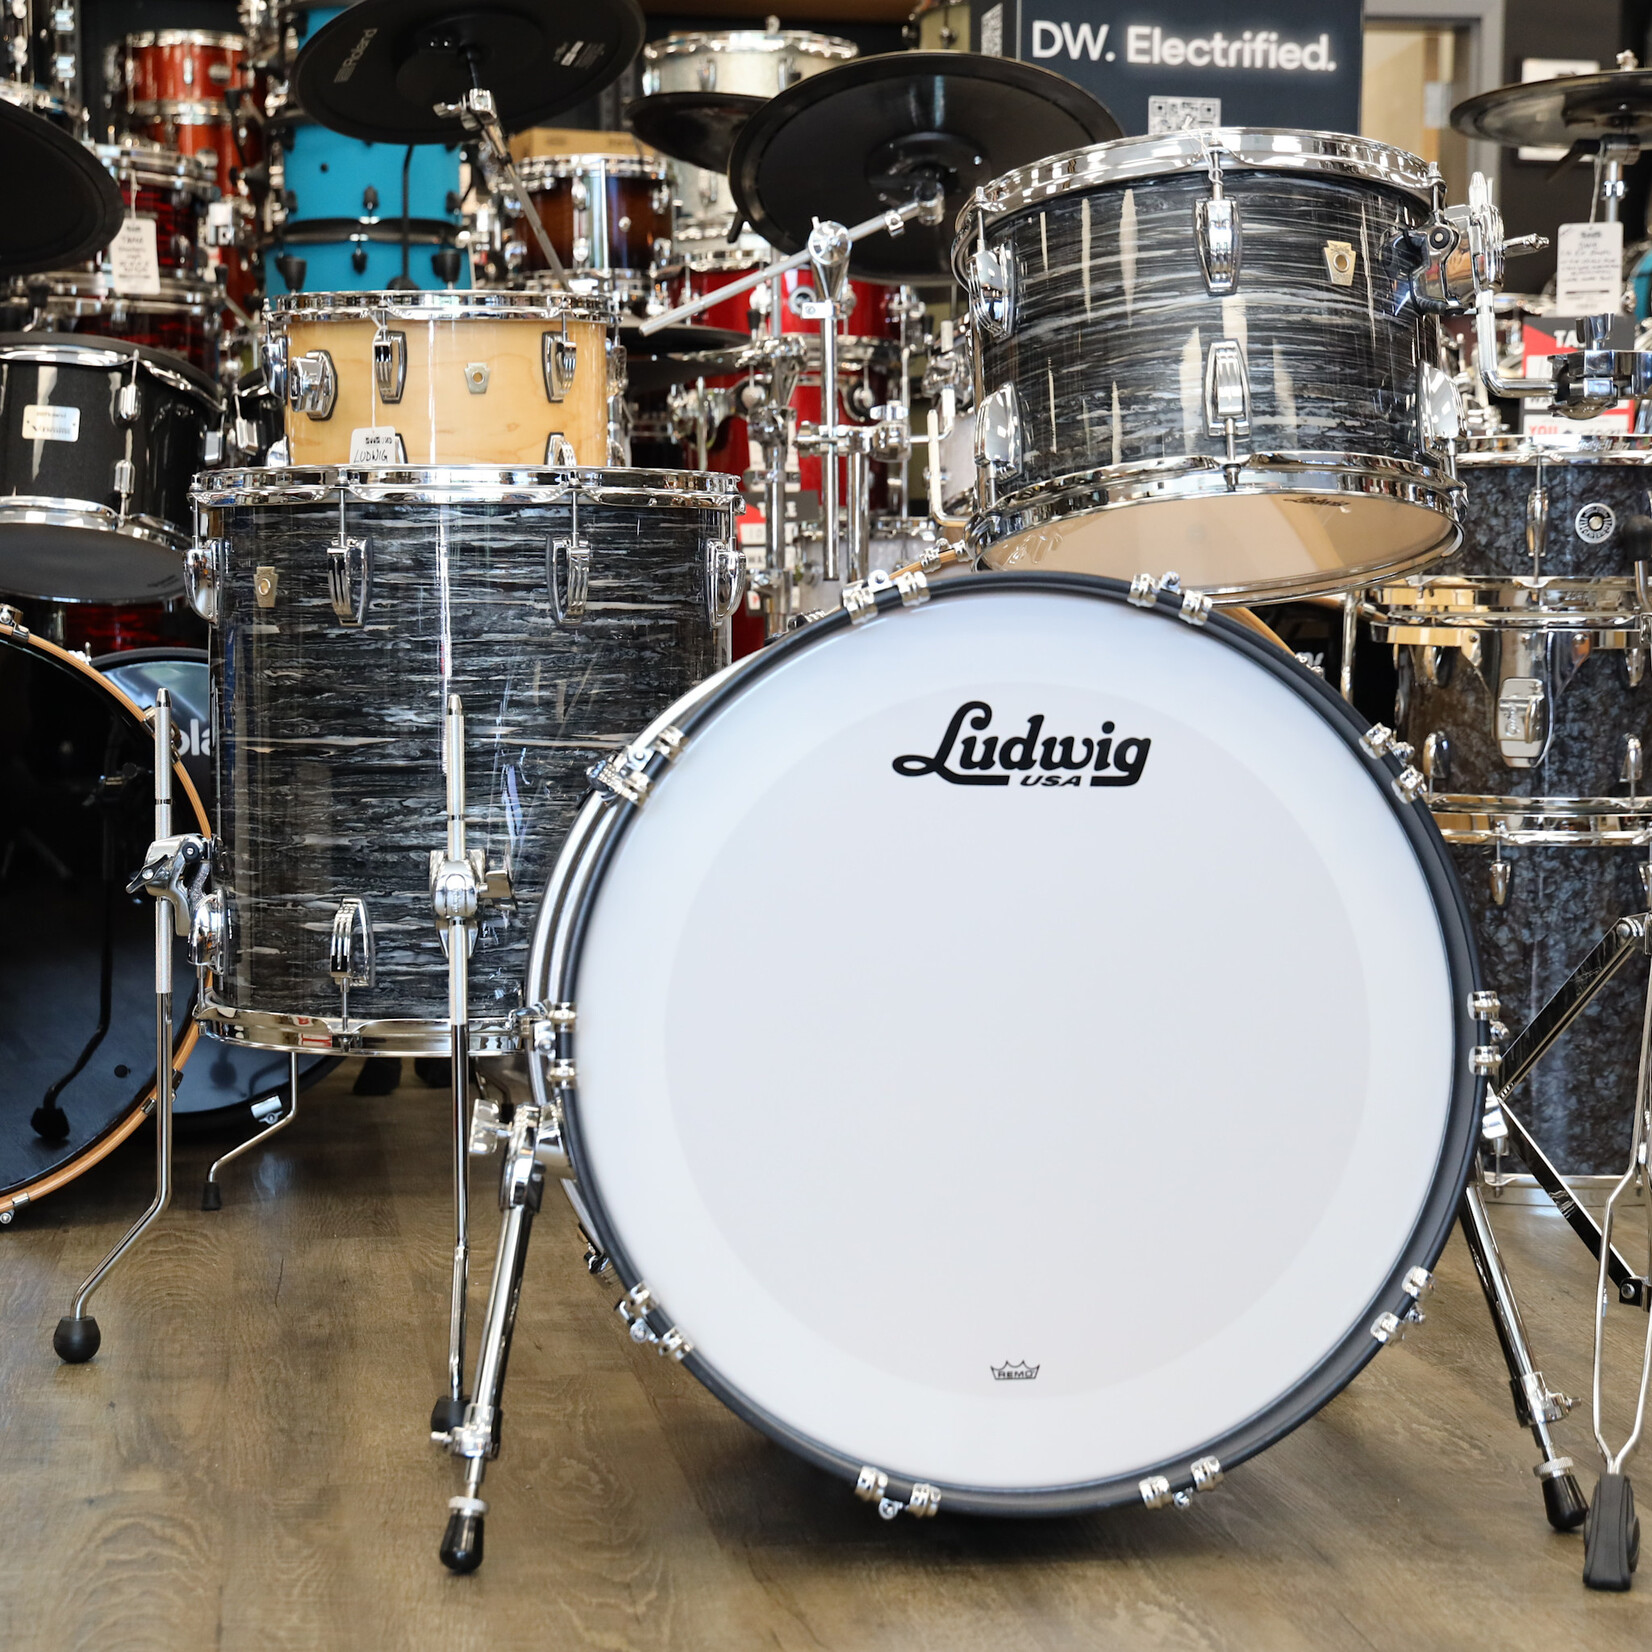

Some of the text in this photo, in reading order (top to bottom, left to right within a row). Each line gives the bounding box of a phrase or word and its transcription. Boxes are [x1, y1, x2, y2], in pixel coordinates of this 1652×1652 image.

[1032, 20, 1337, 71] DW. Electrified.
[353, 449, 388, 463] LUDWIG
[892, 700, 1152, 787] Ludwig
[1020, 775, 1082, 787] USA
[998, 1370, 1034, 1379] REMO
